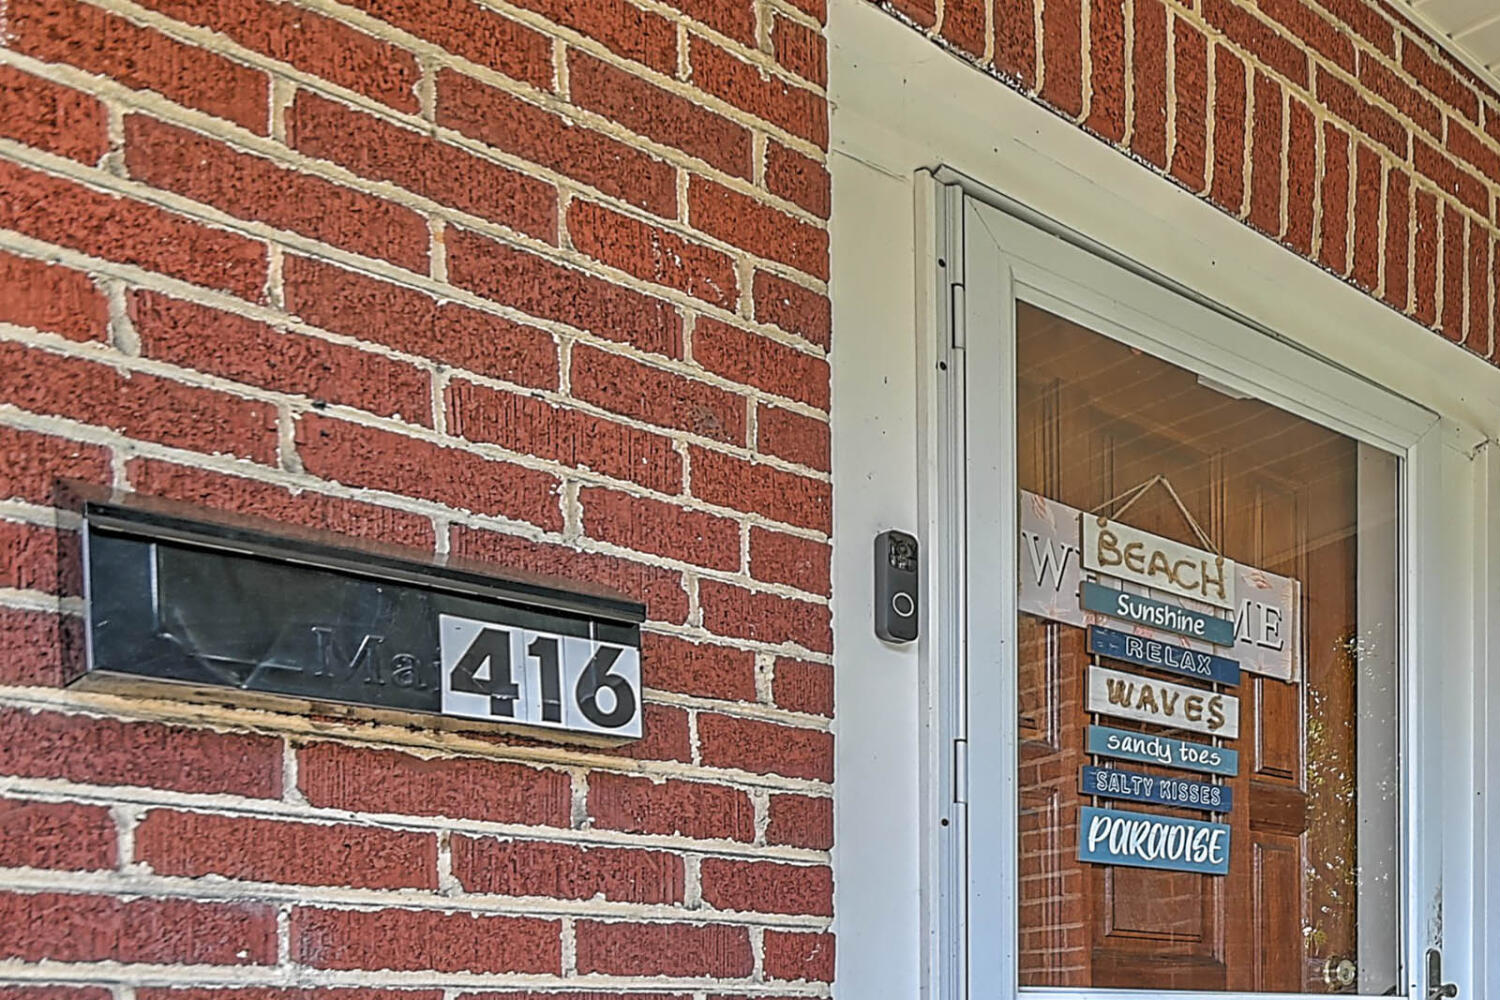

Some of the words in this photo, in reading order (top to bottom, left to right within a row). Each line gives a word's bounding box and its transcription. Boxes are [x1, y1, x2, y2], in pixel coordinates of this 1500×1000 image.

[1097, 529, 1226, 600] BEACH
[1116, 593, 1206, 636] Sunshine
[1125, 636, 1212, 676] RELAX
[449, 627, 638, 729] 416
[1106, 677, 1226, 732] WAVES
[1106, 734, 1172, 764] sandy
[1179, 741, 1222, 766] toes
[1095, 771, 1154, 797] SALTY
[1159, 780, 1222, 806] KISSES
